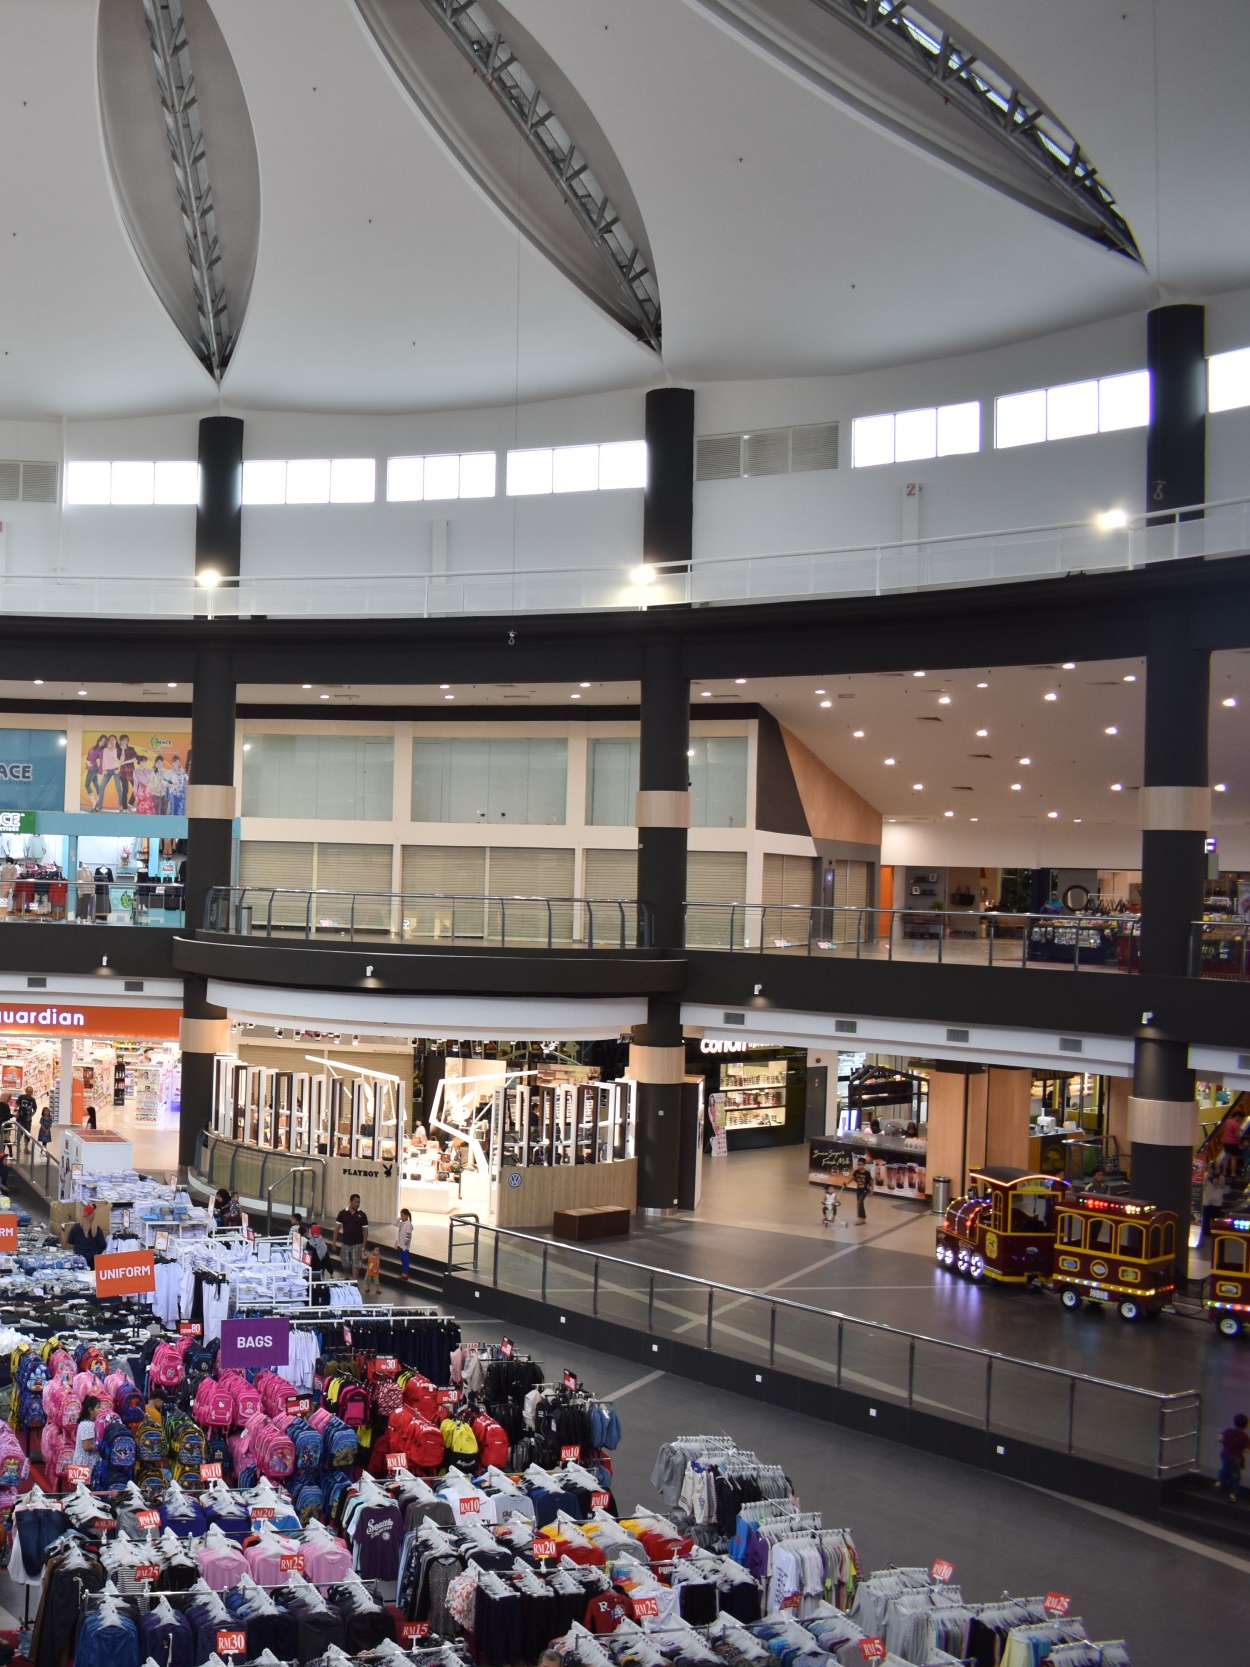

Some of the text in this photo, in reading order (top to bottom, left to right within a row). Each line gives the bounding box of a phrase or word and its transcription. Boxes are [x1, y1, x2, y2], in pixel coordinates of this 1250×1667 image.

[907, 483, 917, 497] 2
[342, 1168, 379, 1178] PLAYBOY
[99, 1264, 151, 1281] UNIFORM
[191, 1323, 201, 1333] 80
[236, 1334, 273, 1348] BAGS
[386, 1359, 396, 1370] 30
[448, 1390, 458, 1402] 30
[299, 1399, 310, 1411] 80
[561, 1446, 580, 1459] RM10
[387, 1453, 407, 1468] RM10
[68, 1466, 89, 1480] RM25
[201, 1464, 221, 1479] RM10
[460, 1498, 480, 1513] RM10
[591, 1493, 609, 1506] RM10
[139, 1511, 160, 1526] RM10
[251, 1508, 274, 1518] RM20
[533, 1541, 556, 1555] RM20
[280, 1556, 304, 1570] RM25
[136, 1565, 159, 1580] RM25
[635, 1599, 658, 1616] RM25
[403, 1623, 429, 1636] RM15
[218, 1633, 245, 1650] RM30
[863, 1639, 883, 1656] RM5
